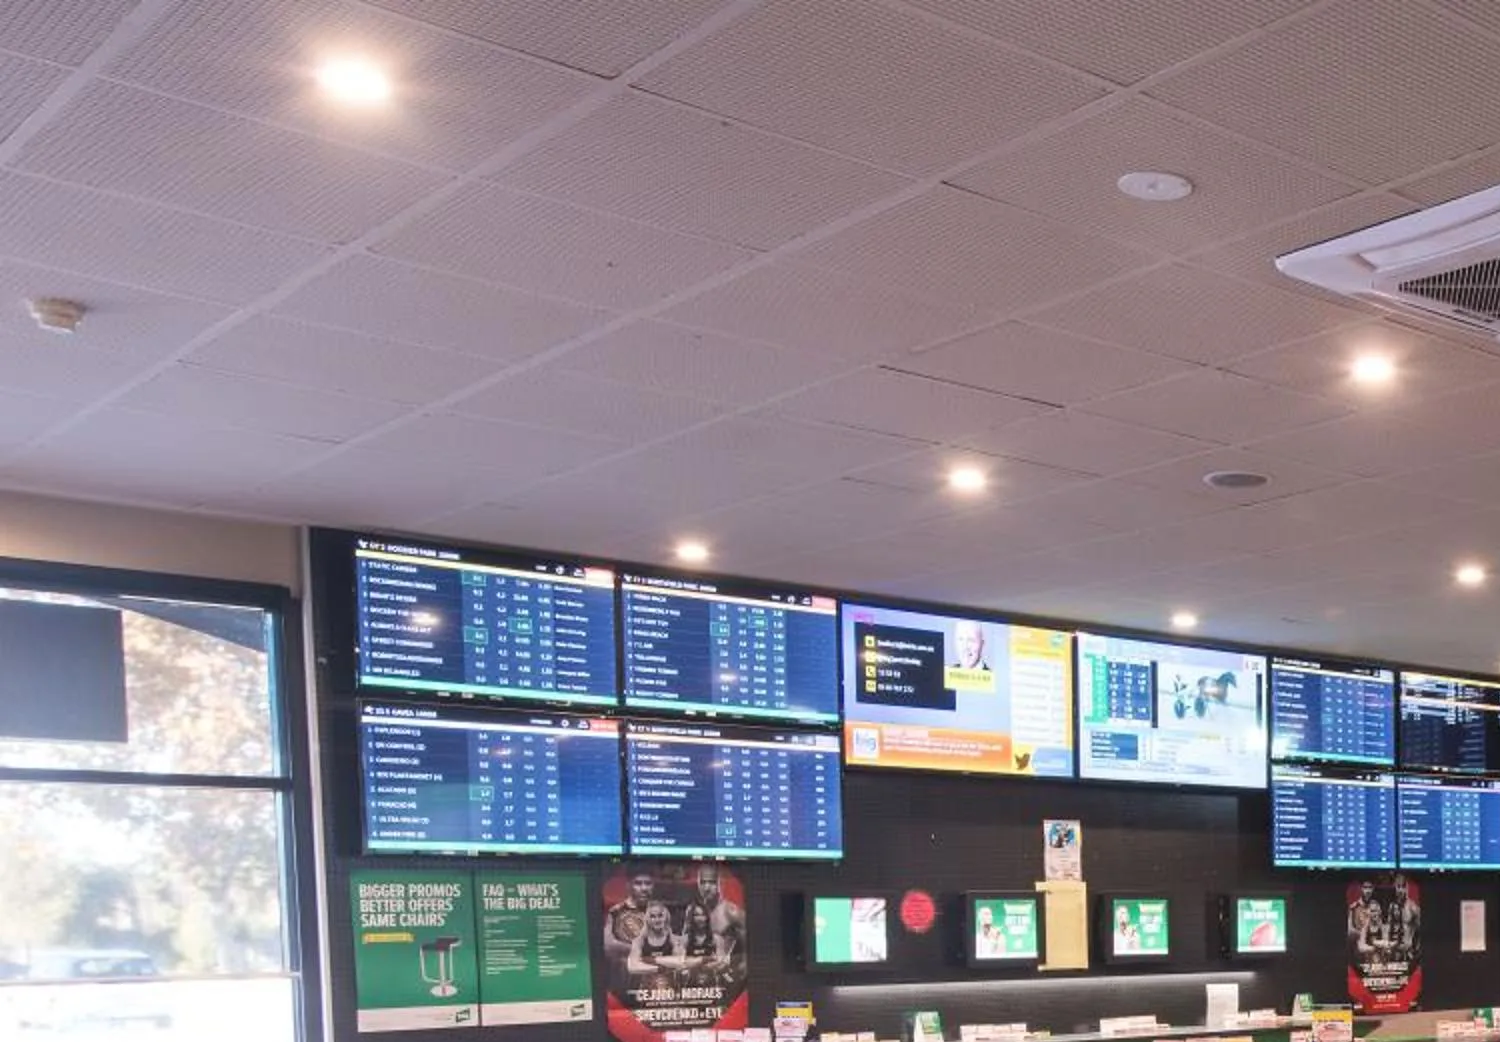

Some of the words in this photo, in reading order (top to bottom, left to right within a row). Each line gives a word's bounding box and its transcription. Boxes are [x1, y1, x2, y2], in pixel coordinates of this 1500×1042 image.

[360, 884, 404, 898] BIGGER
[408, 884, 461, 897] PROMOS
[483, 884, 504, 896] FAQ
[517, 883, 559, 896] WHAT'S
[360, 899, 404, 912] BETTER
[408, 898, 453, 911] OFFERS
[484, 898, 504, 910] THE
[507, 898, 526, 909] BIG
[361, 914, 397, 927] SAME
[682, 986, 722, 999] MORAES
